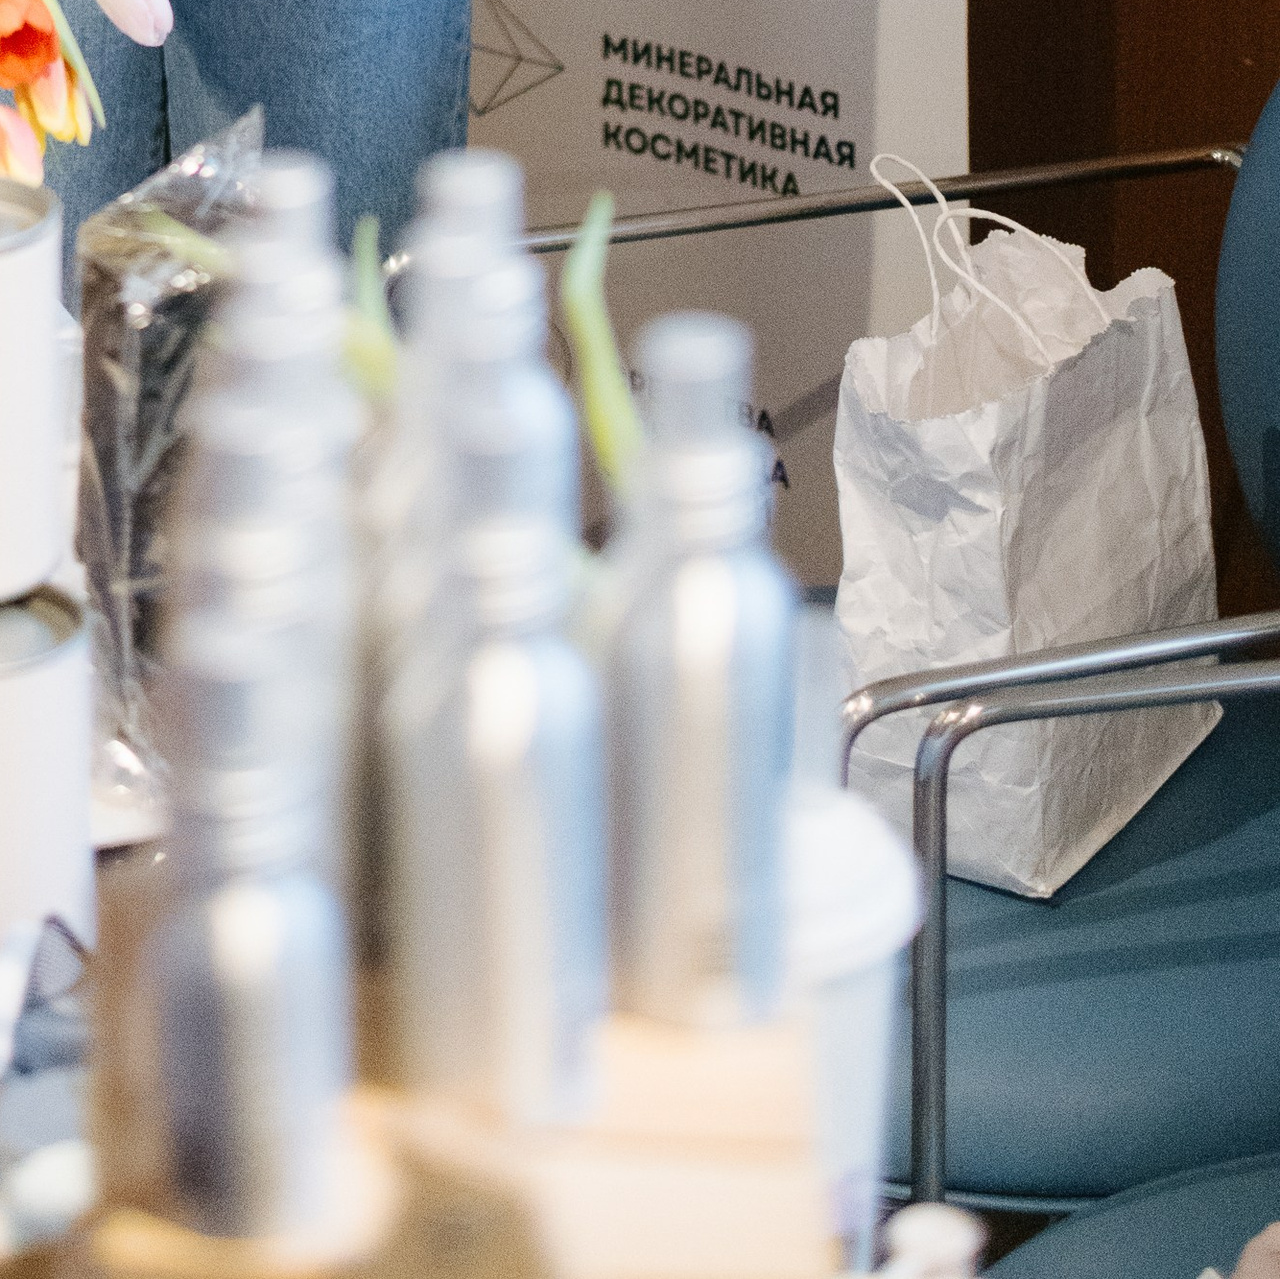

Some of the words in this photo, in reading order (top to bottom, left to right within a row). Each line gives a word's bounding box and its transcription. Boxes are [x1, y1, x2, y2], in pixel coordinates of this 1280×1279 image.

[601, 33, 842, 120] МИНЕРАЛЬНАЯ
[601, 78, 858, 170] ДЕКОРАТИВНАЯ
[602, 122, 801, 197] КОСМЕТИКА
